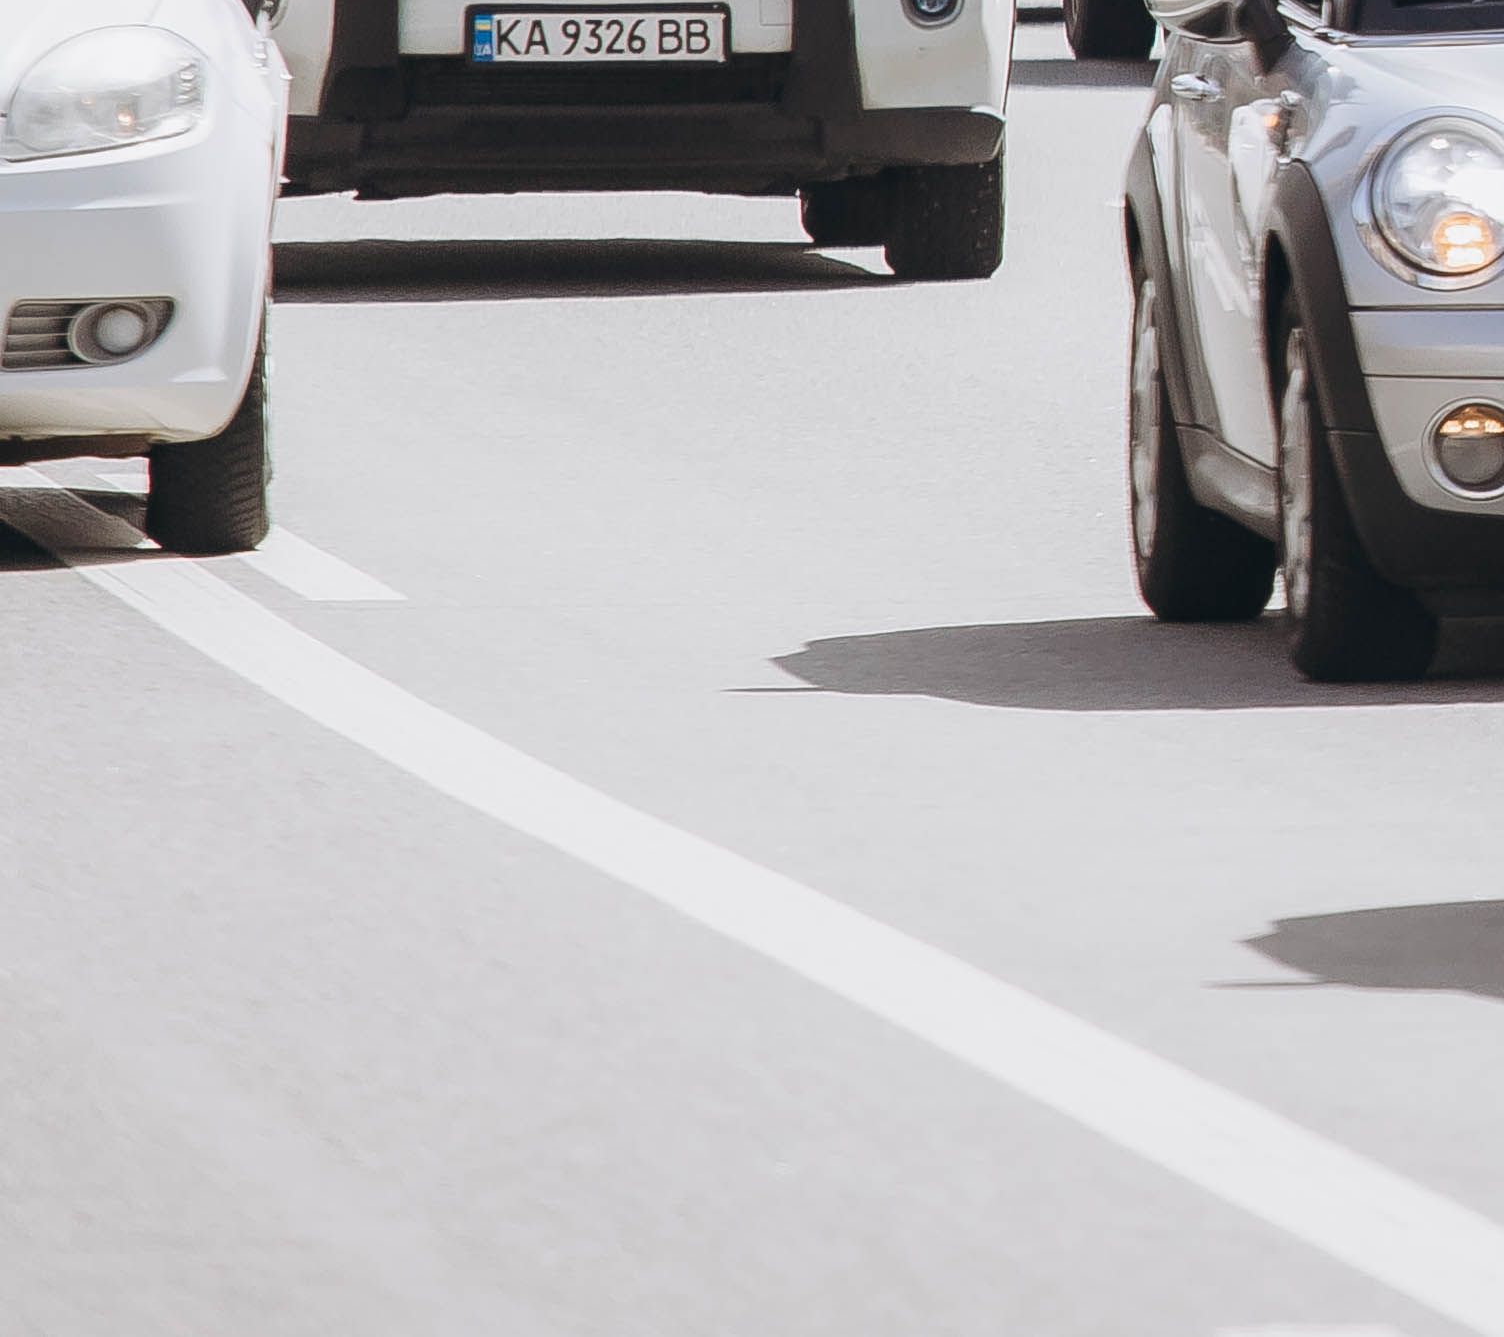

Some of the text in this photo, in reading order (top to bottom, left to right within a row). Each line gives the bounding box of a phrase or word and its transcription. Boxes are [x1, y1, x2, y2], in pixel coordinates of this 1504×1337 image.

[496, 18, 711, 56] KA 9326 BB
